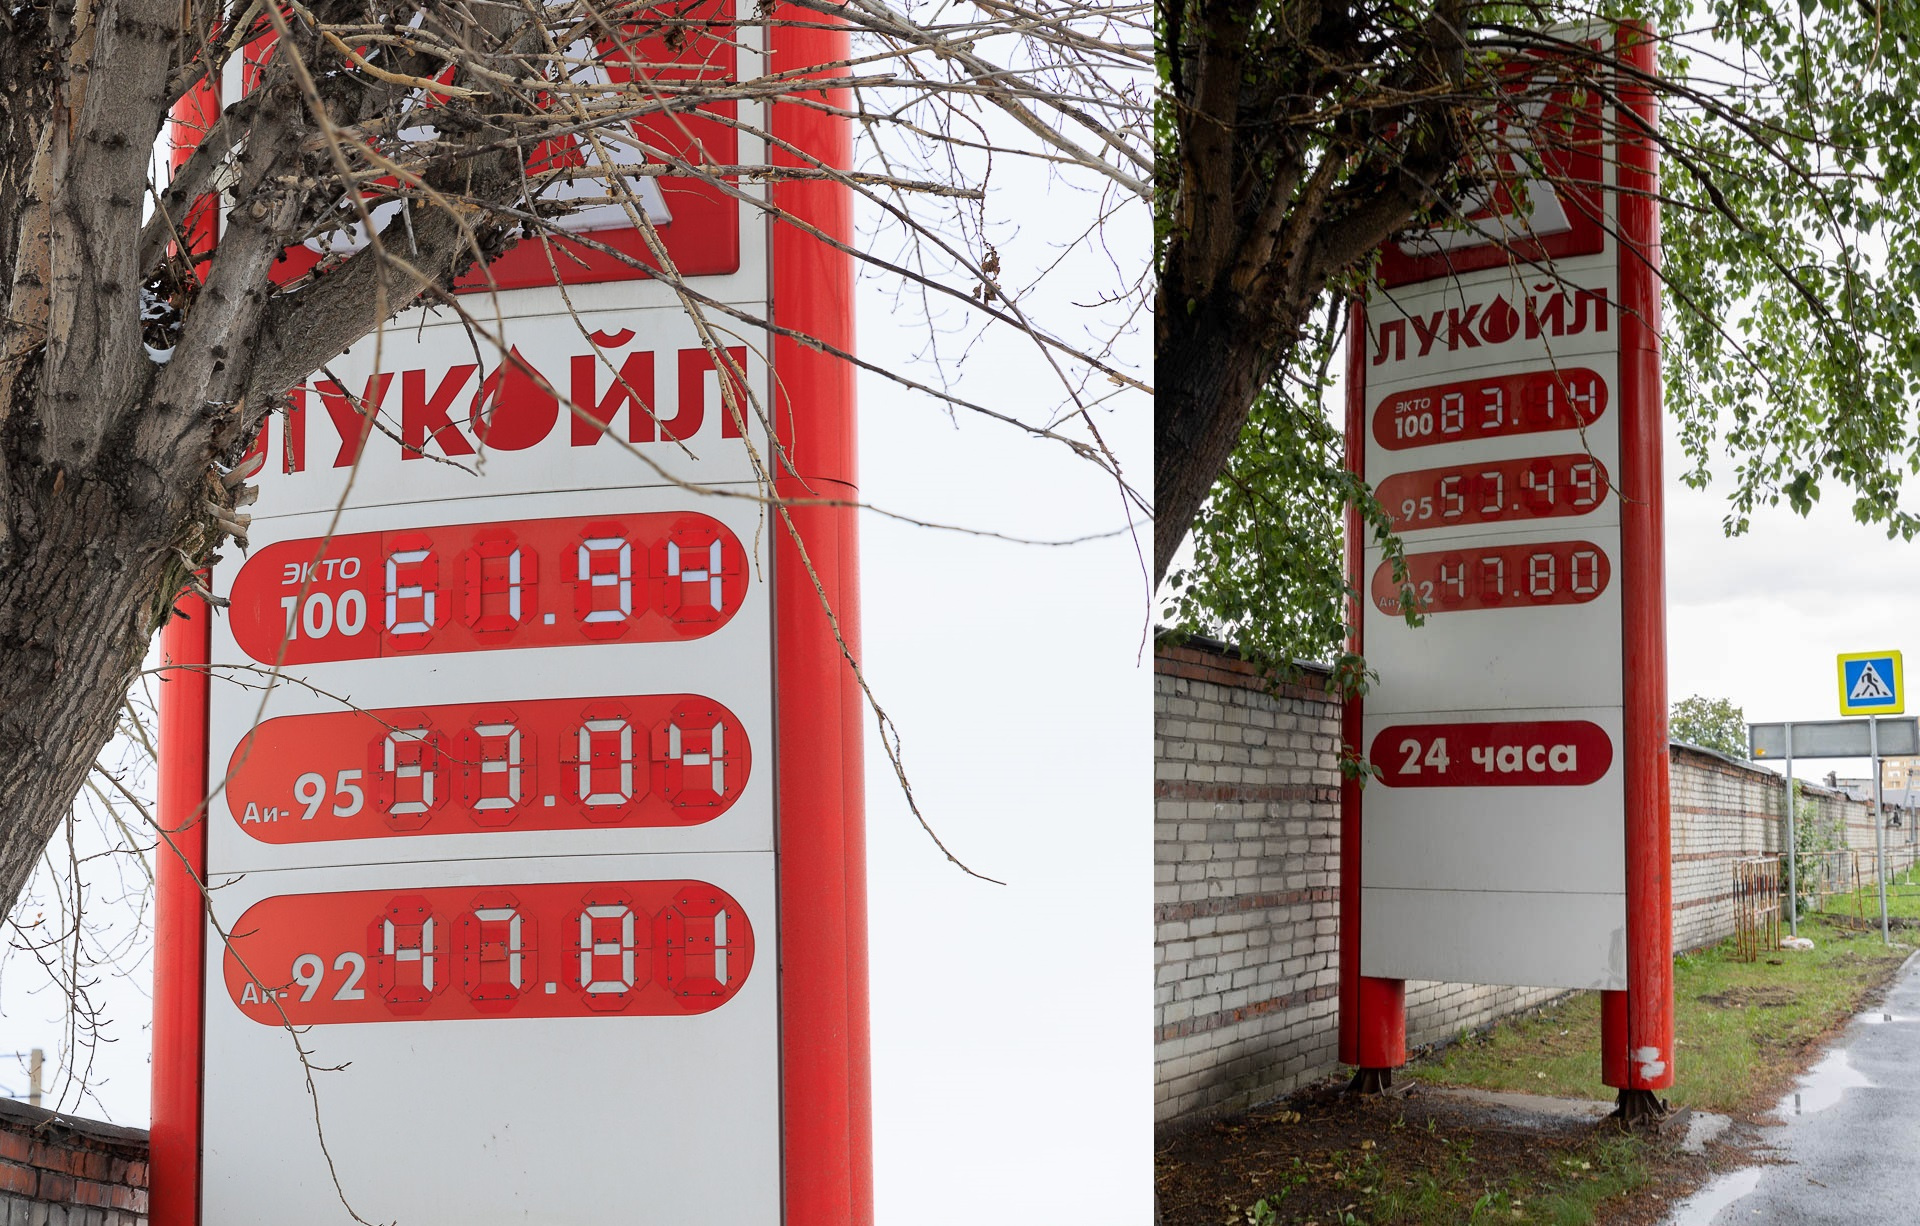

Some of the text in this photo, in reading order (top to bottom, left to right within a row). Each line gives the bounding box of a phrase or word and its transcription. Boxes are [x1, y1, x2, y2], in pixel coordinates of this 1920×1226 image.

[1373, 282, 1608, 367] ЛУКОЙЛ
[1394, 379, 1597, 439] 100 83.14
[1395, 398, 1431, 414] ЭКТО
[280, 537, 723, 641] 100 61.94
[281, 557, 361, 585] ЭКТО
[1441, 550, 1598, 598] 47.80
[241, 719, 725, 825] Аи-95 53.04
[1398, 737, 1578, 775] 24 часа
[239, 904, 728, 1005] Аи-92 47.81
